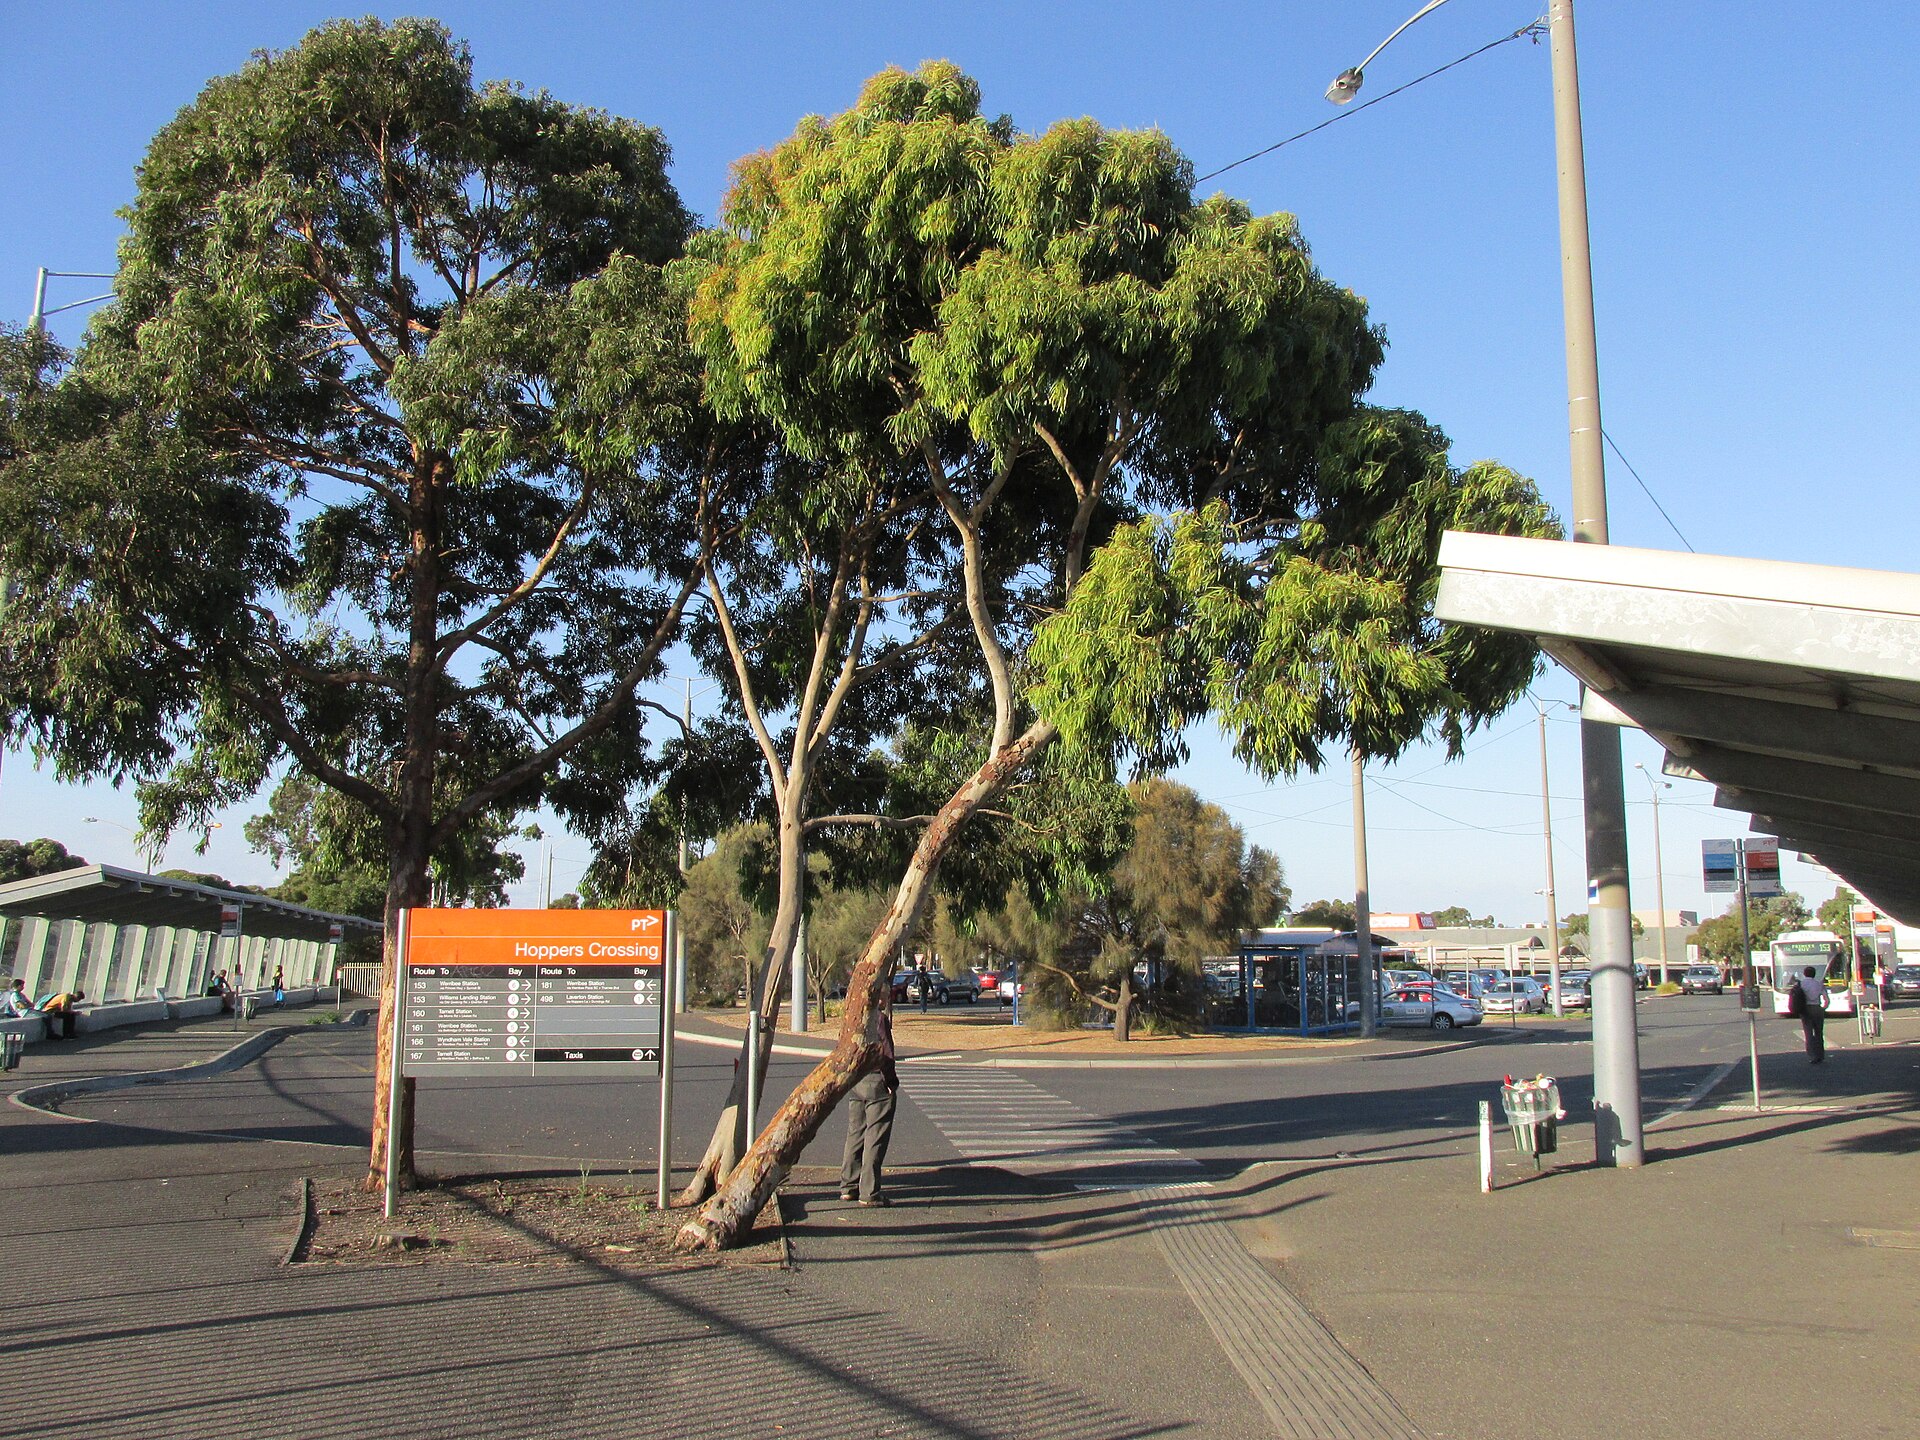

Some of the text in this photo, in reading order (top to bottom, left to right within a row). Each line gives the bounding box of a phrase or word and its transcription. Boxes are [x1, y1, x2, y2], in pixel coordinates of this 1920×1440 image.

[515, 942, 659, 960] Hoppers Crossing
[508, 968, 522, 976] Bay
[634, 968, 648, 976] Bay
